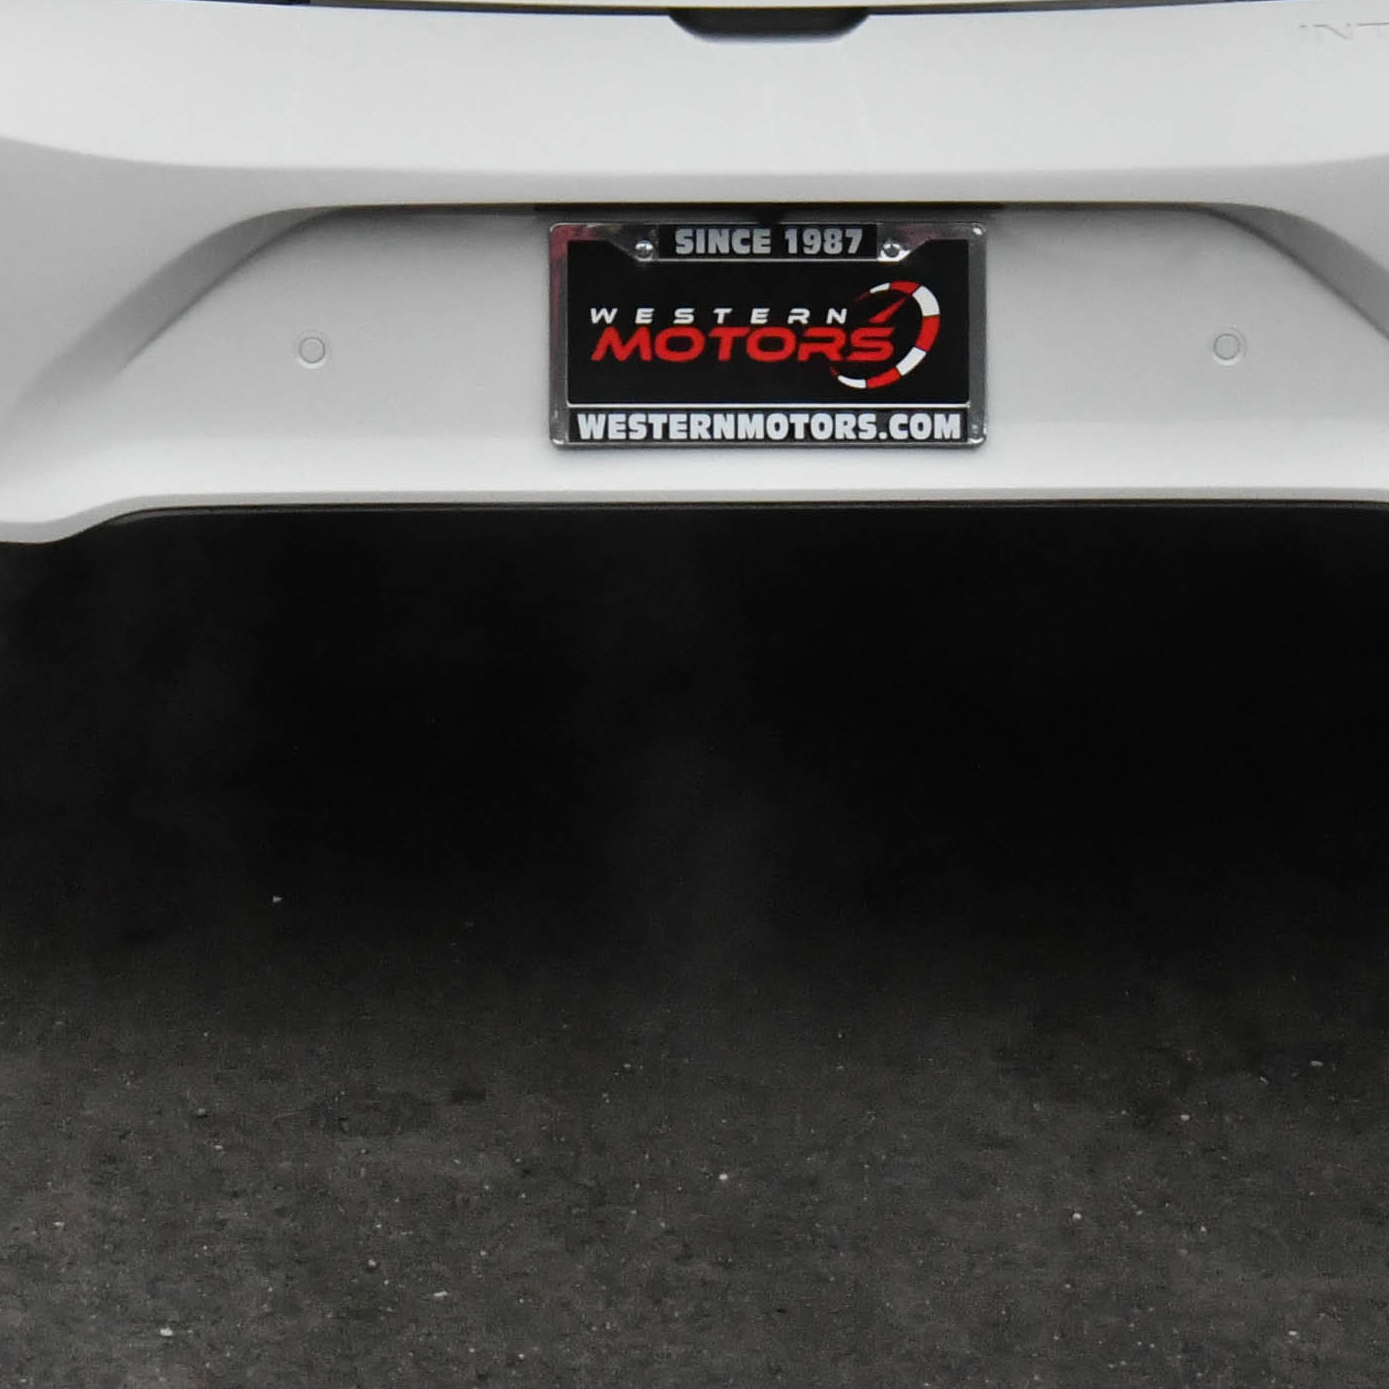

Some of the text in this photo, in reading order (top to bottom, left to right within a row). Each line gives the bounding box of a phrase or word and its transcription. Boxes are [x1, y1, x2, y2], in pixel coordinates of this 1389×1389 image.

[675, 228, 863, 255] SINCE 1987
[590, 307, 848, 325] WESTERN
[591, 326, 895, 362] MOTORS
[577, 412, 962, 441] WESTERNMOTORS.COM
